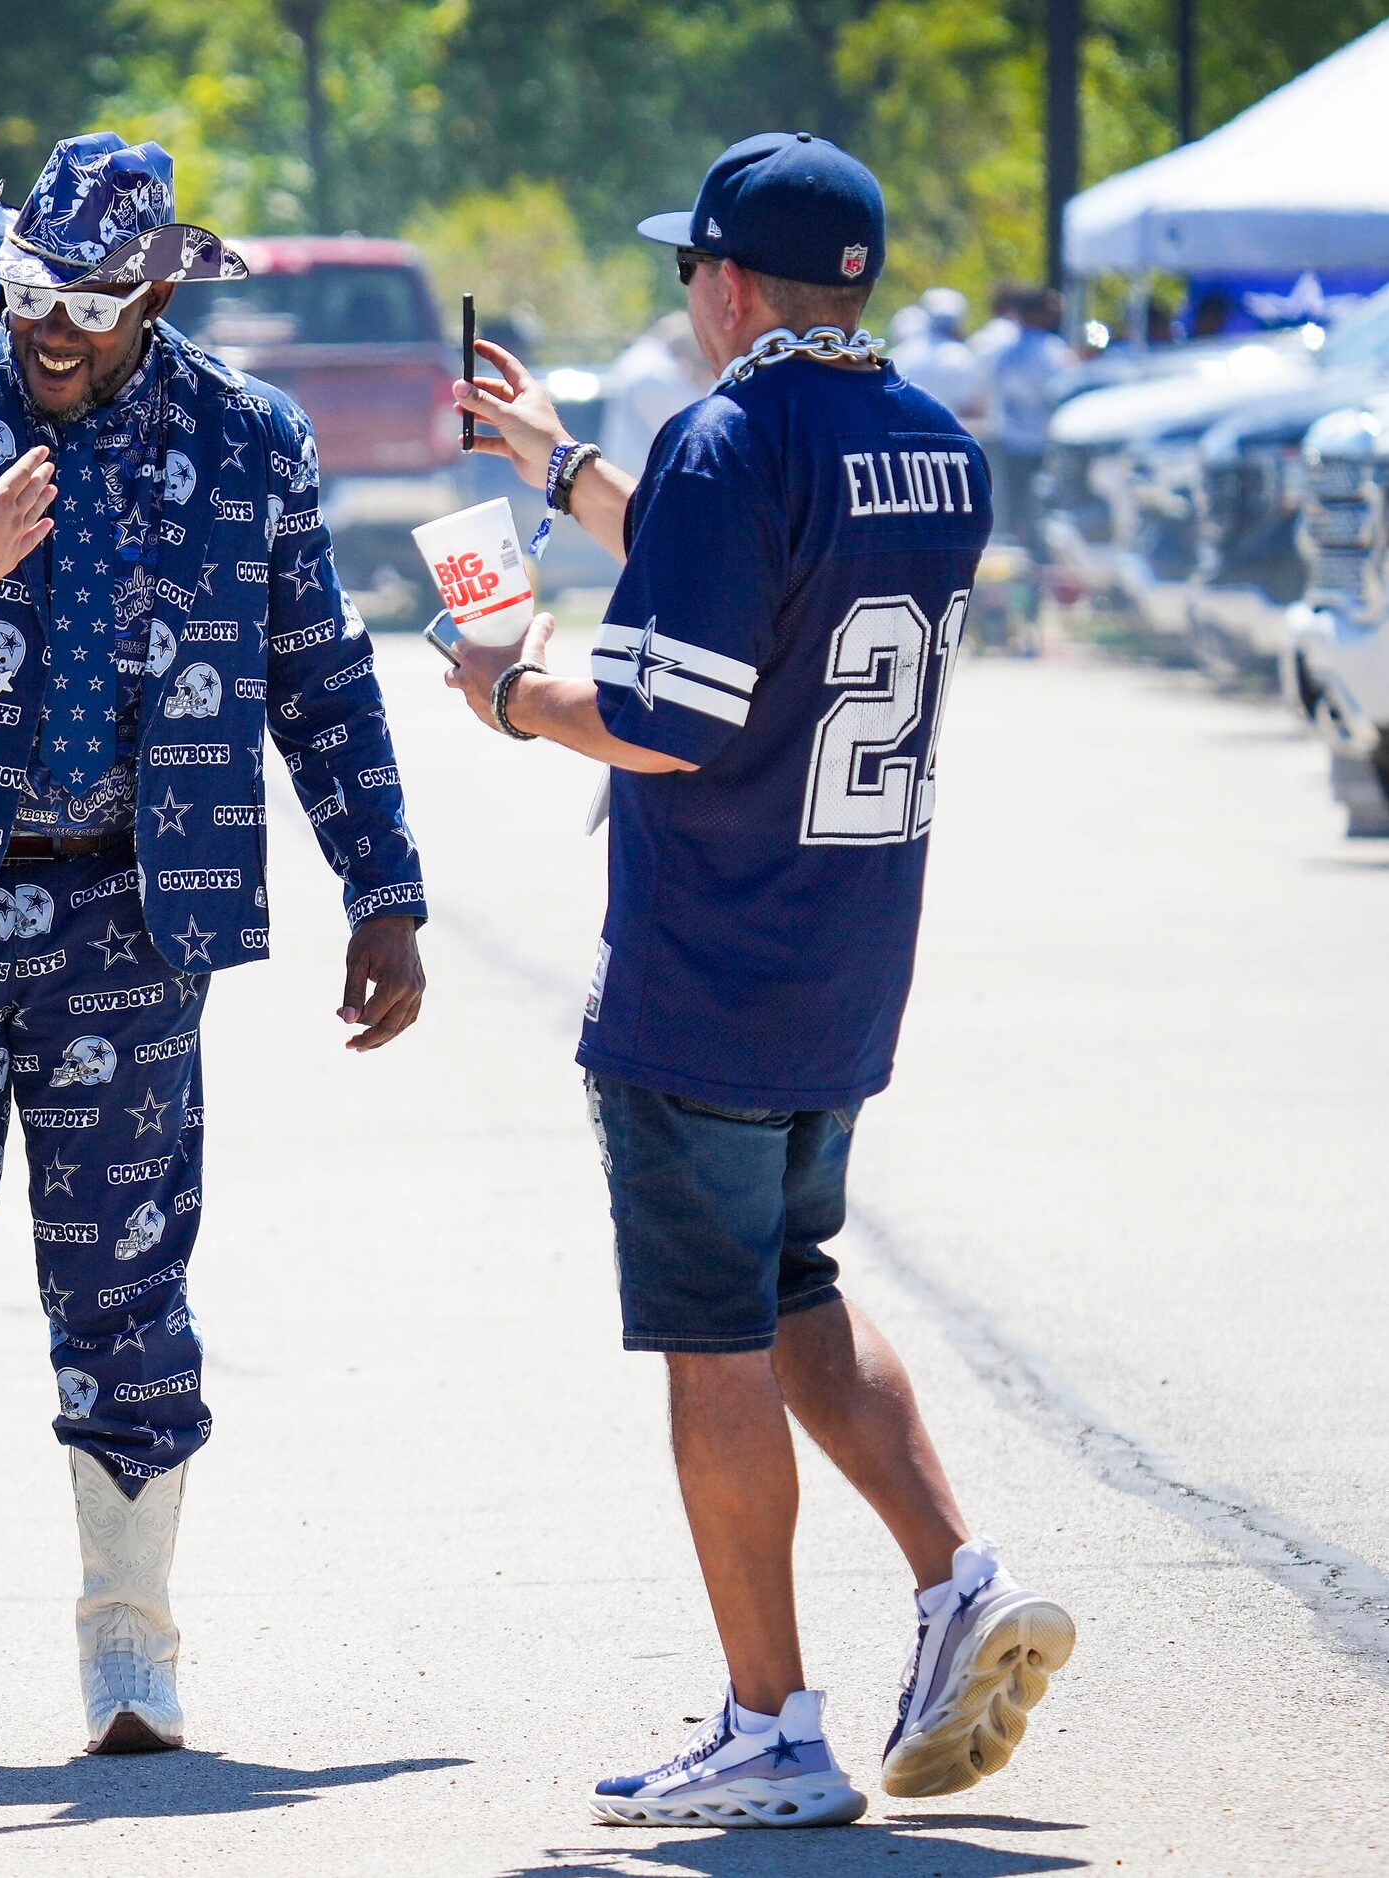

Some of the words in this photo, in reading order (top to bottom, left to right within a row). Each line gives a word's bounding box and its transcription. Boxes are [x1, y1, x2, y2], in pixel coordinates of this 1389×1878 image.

[842, 451, 974, 518] ELLIOTT
[463, 610, 483, 622] LARGE
[800, 588, 971, 847] 21
[150, 744, 230, 766] COWBOYS
[158, 868, 241, 892] COWBOYS
[68, 982, 164, 1015] COWBOYS
[98, 1259, 186, 1309] COWBOYS
[114, 1369, 199, 1402] COWBOYS
